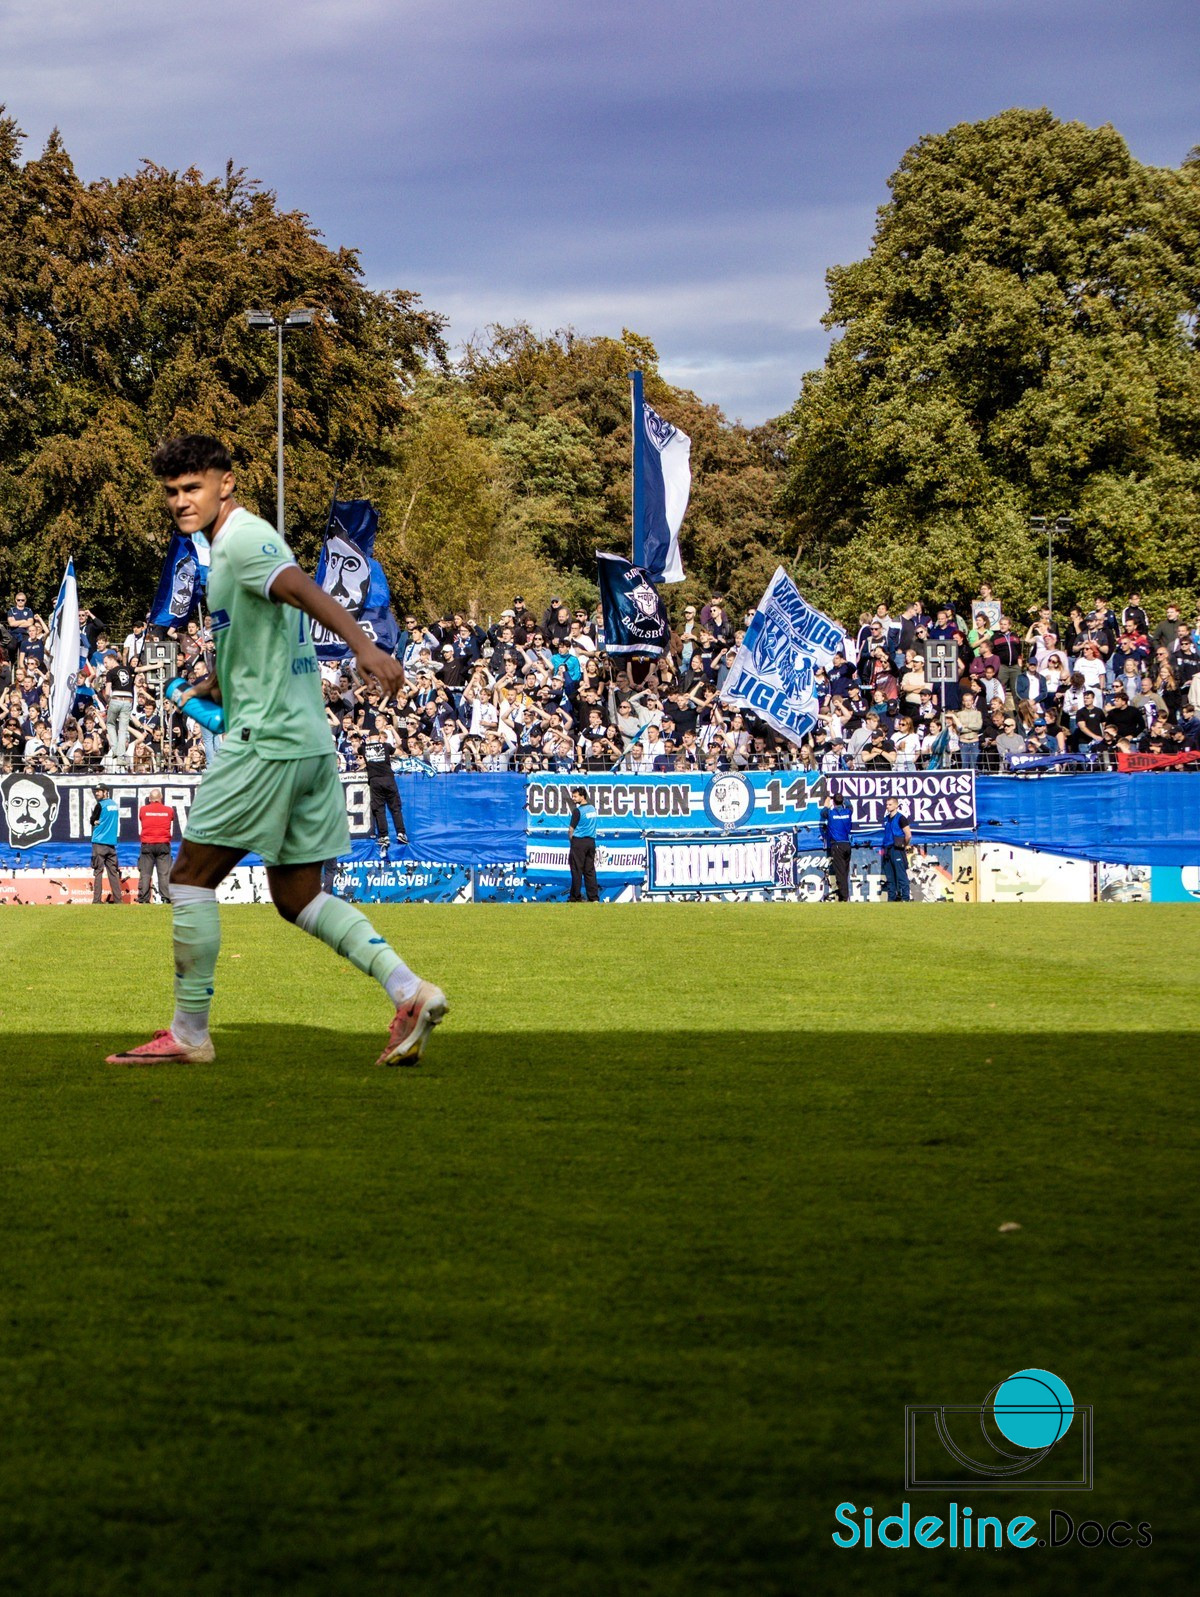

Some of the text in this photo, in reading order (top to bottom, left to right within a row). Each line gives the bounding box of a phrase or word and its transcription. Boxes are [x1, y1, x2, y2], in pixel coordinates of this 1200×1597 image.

[826, 774, 972, 798] UNDERDOGS
[366, 874, 396, 887] Yalla
[479, 874, 502, 887] Nur
